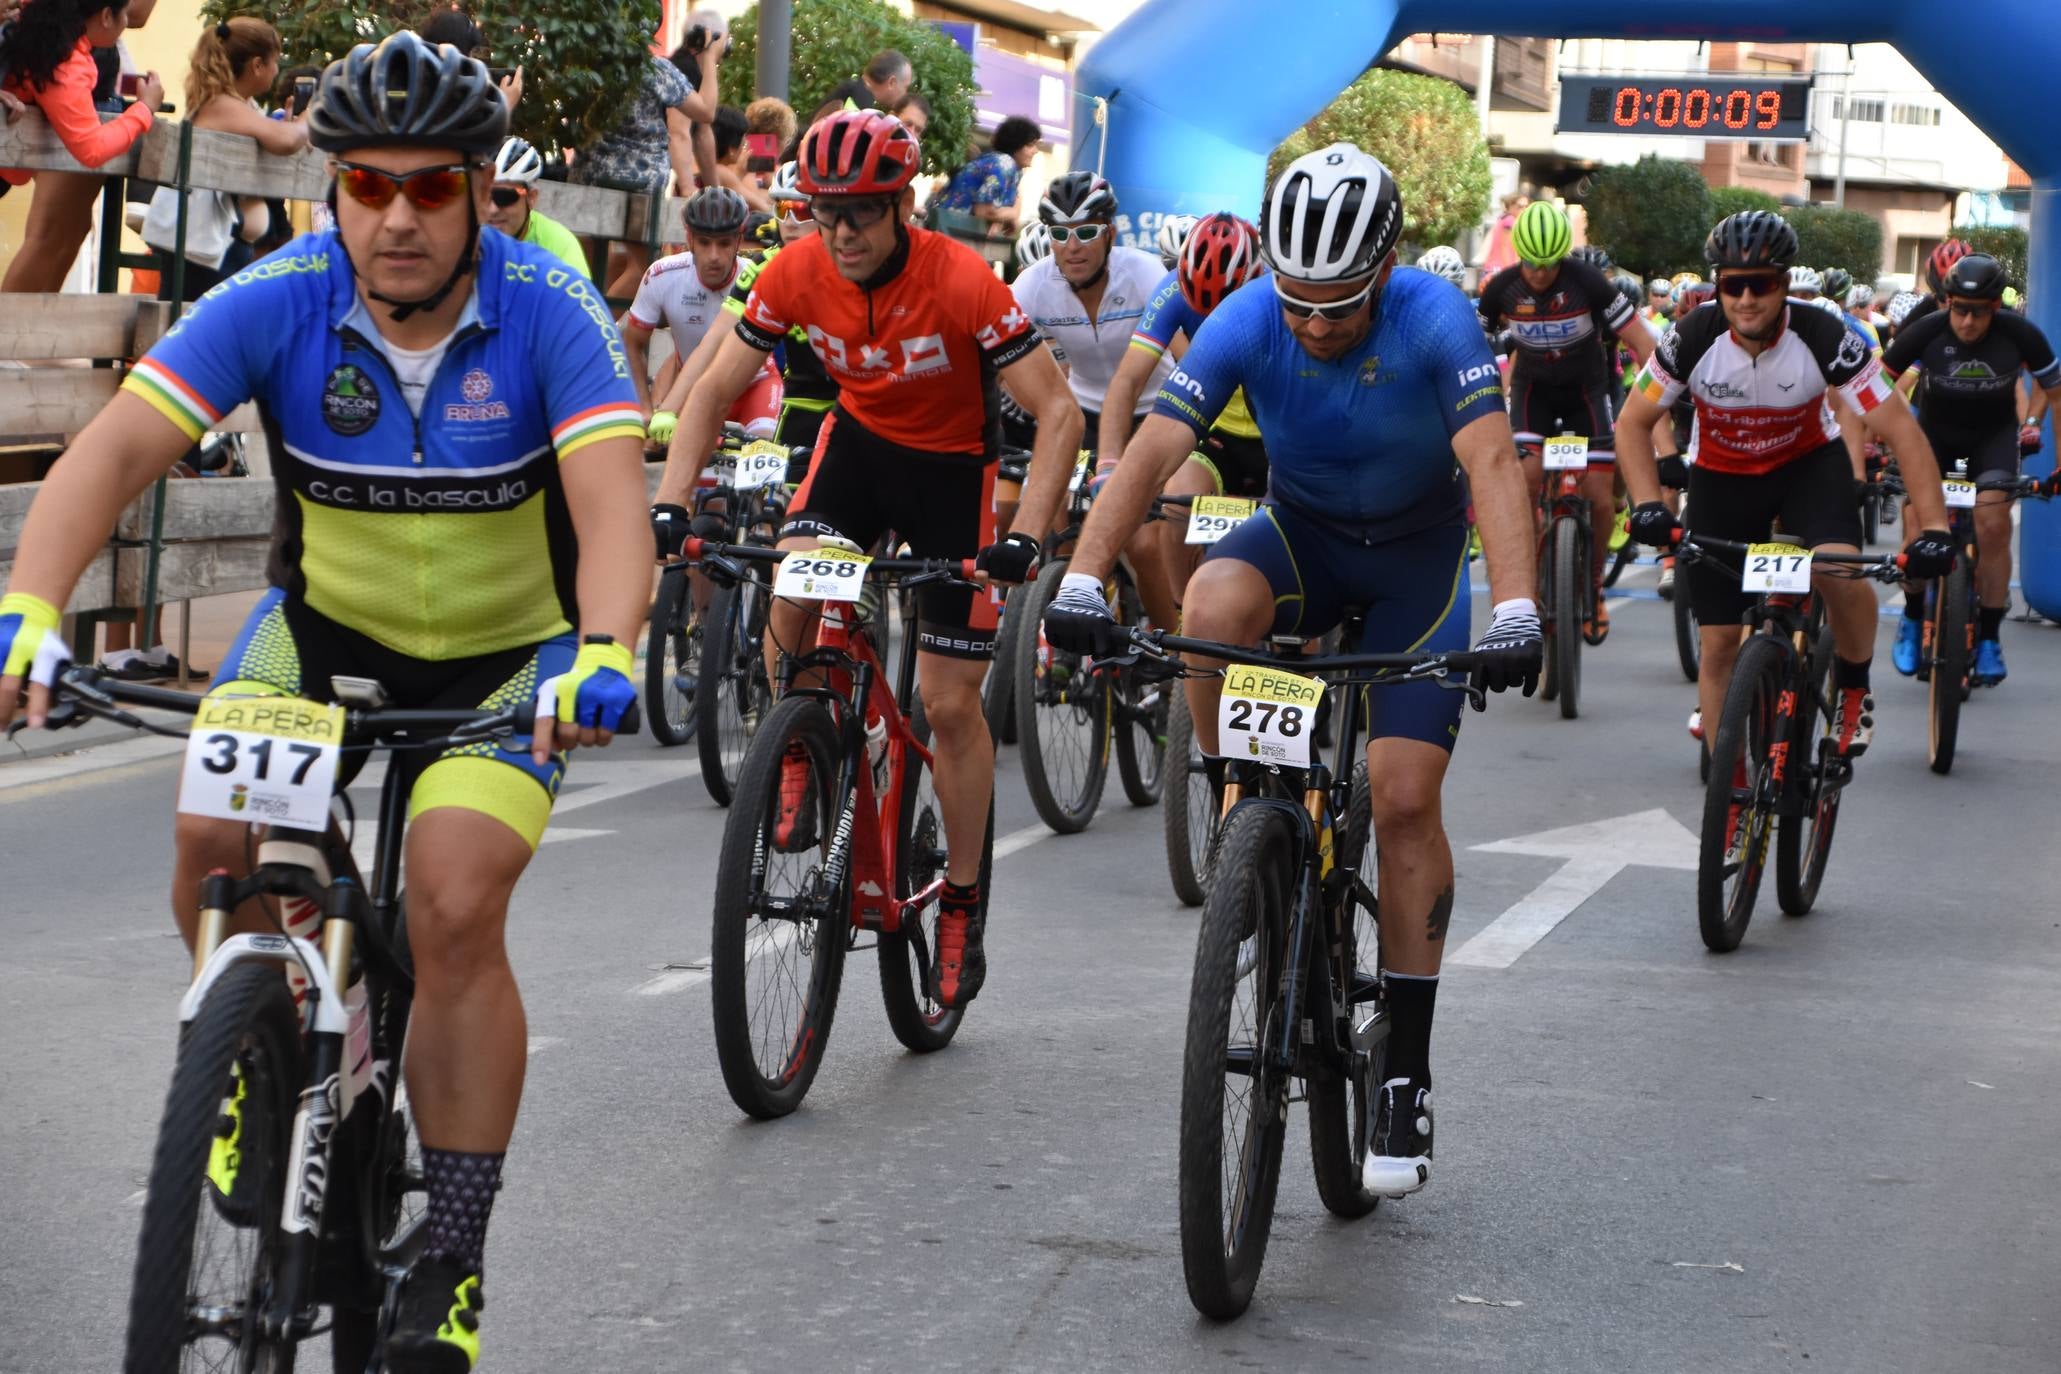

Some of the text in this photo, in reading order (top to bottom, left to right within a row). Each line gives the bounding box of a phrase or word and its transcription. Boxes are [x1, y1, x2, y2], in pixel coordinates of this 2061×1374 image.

[1613, 86, 1781, 130] 0:00:09
[742, 454, 781, 473] 166
[1550, 444, 1583, 455] 306
[368, 484, 397, 506] la
[404, 479, 529, 507] bascula
[787, 558, 858, 579] 268
[1752, 556, 1805, 573] 217
[1474, 639, 1529, 652] SCOTT
[1228, 674, 1316, 703] LA PERA
[203, 709, 245, 726] LA
[252, 708, 334, 738] PERA
[1228, 699, 1304, 738] 278
[202, 733, 323, 786] 317
